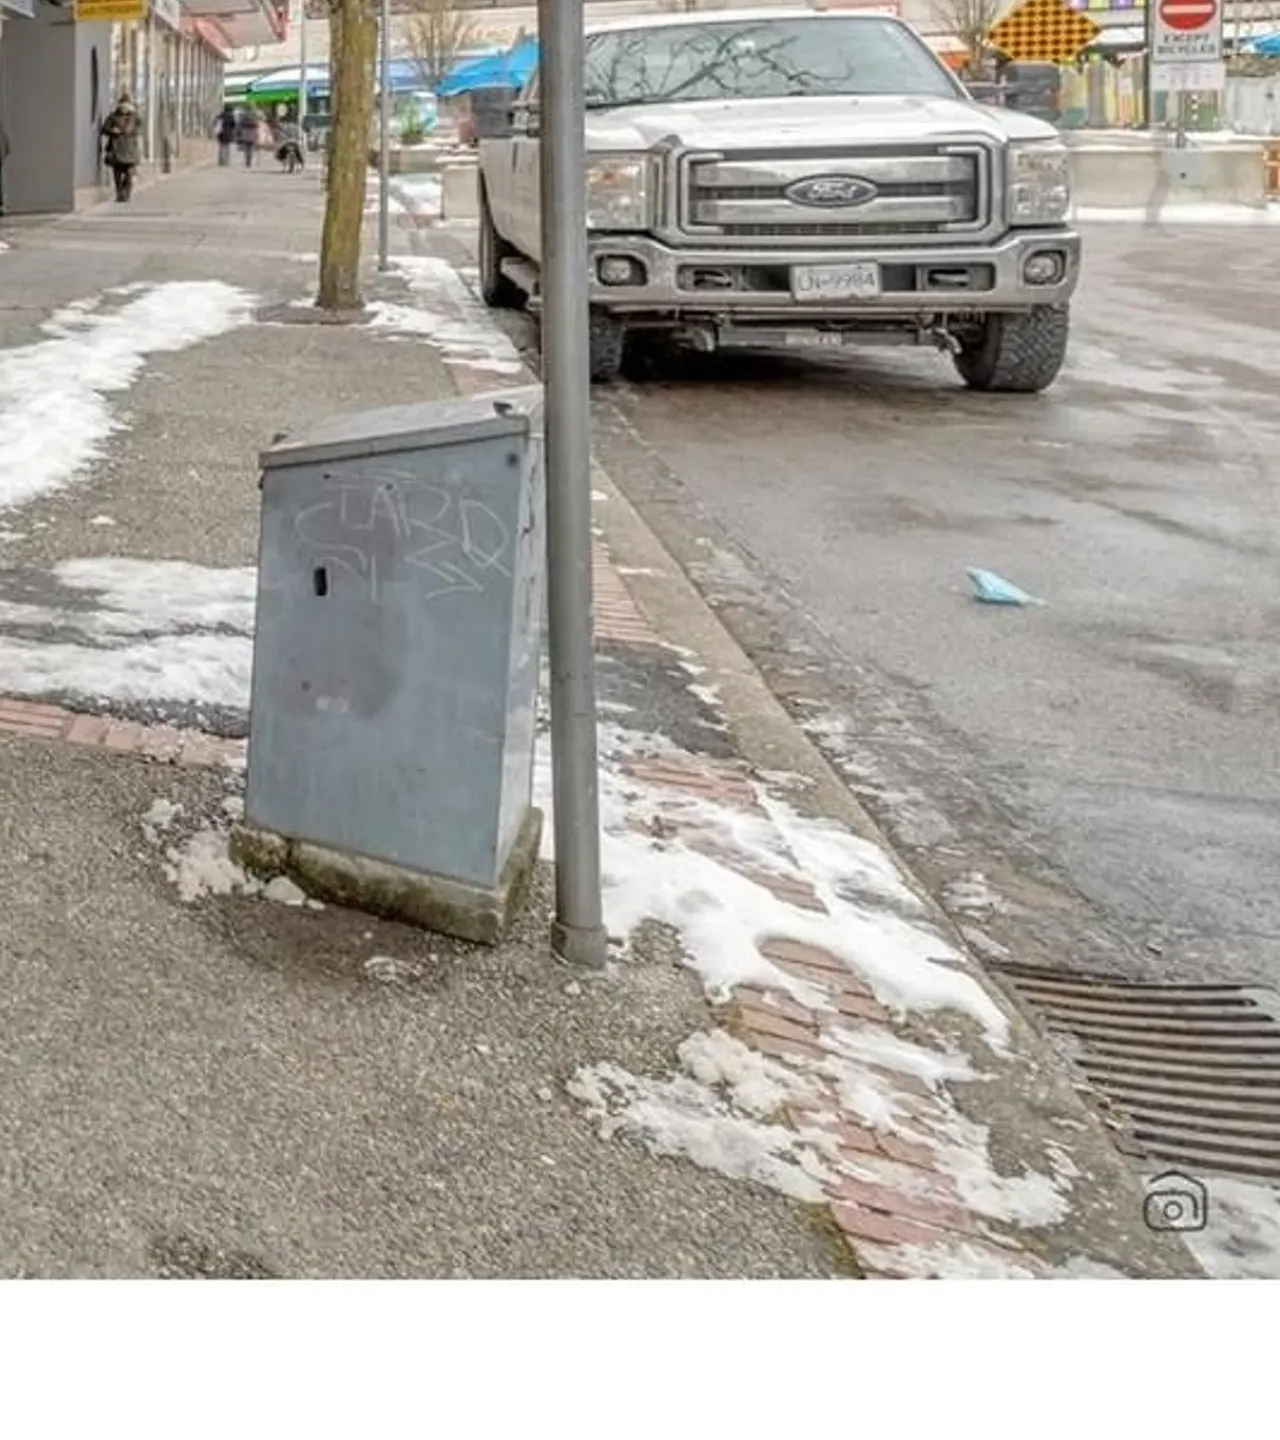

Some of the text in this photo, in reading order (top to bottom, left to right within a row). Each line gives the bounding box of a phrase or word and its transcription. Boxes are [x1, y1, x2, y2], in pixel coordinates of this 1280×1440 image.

[1163, 34, 1210, 43] EXCEPT
[1157, 44, 1216, 55] BICYCLES
[807, 180, 859, 199] Ford
